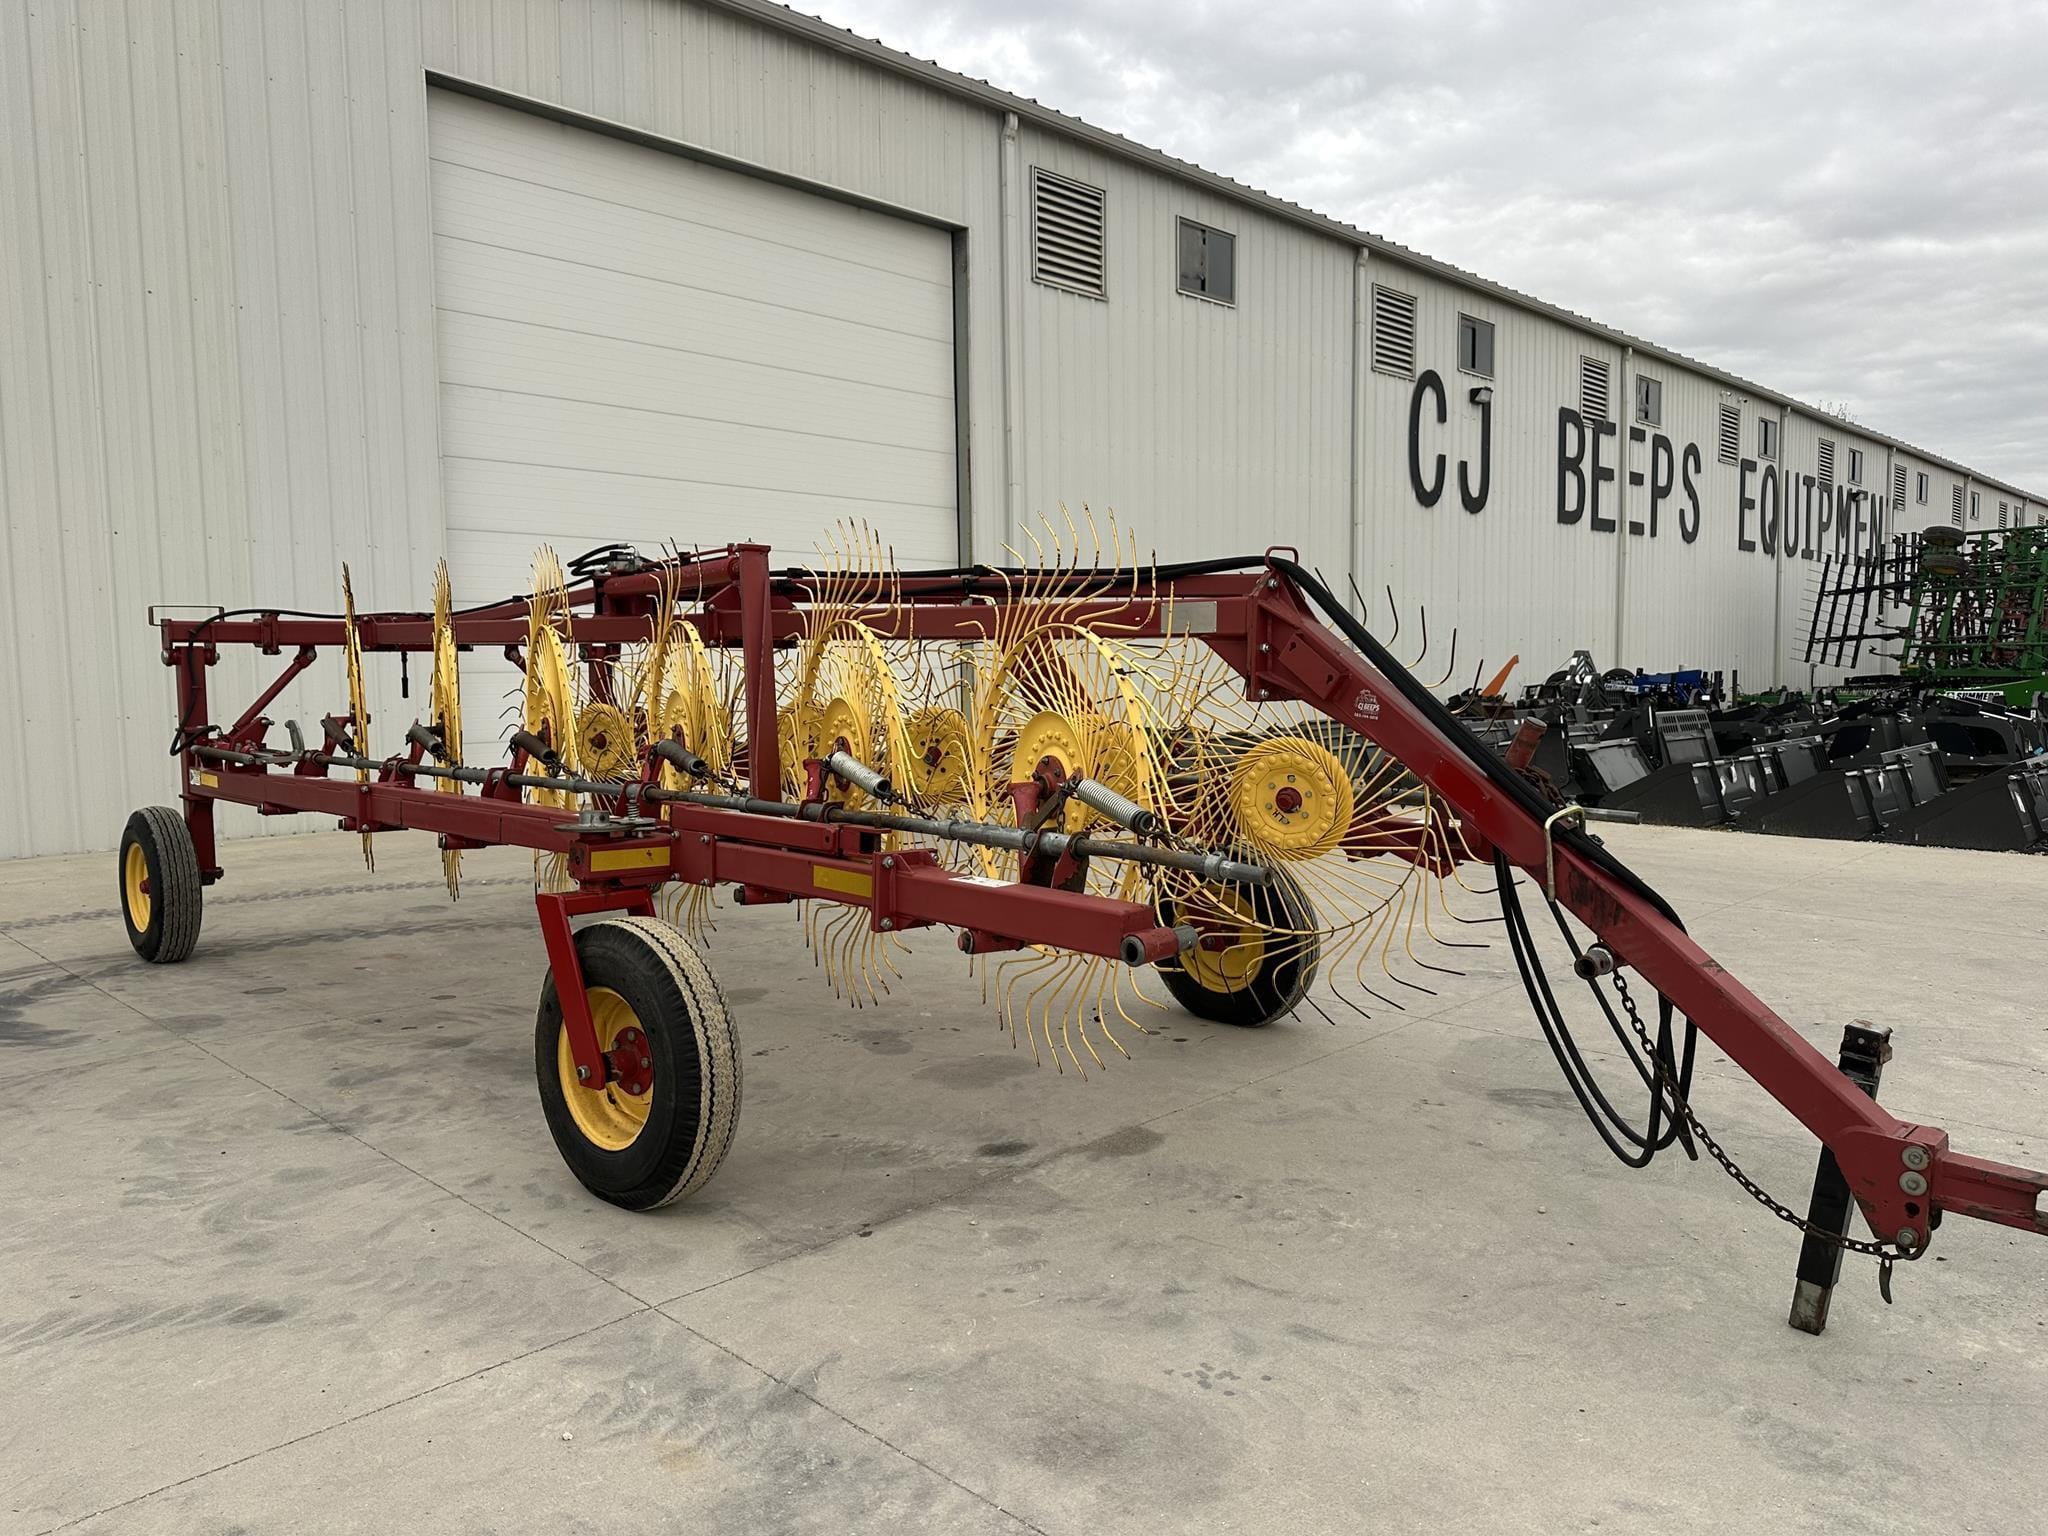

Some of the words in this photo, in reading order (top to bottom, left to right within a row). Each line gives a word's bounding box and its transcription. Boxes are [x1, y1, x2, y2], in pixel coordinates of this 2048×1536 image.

[1409, 369, 1491, 514] CJ
[1557, 406, 1701, 544] BEEPS
[1957, 691, 2000, 701] SUMME
